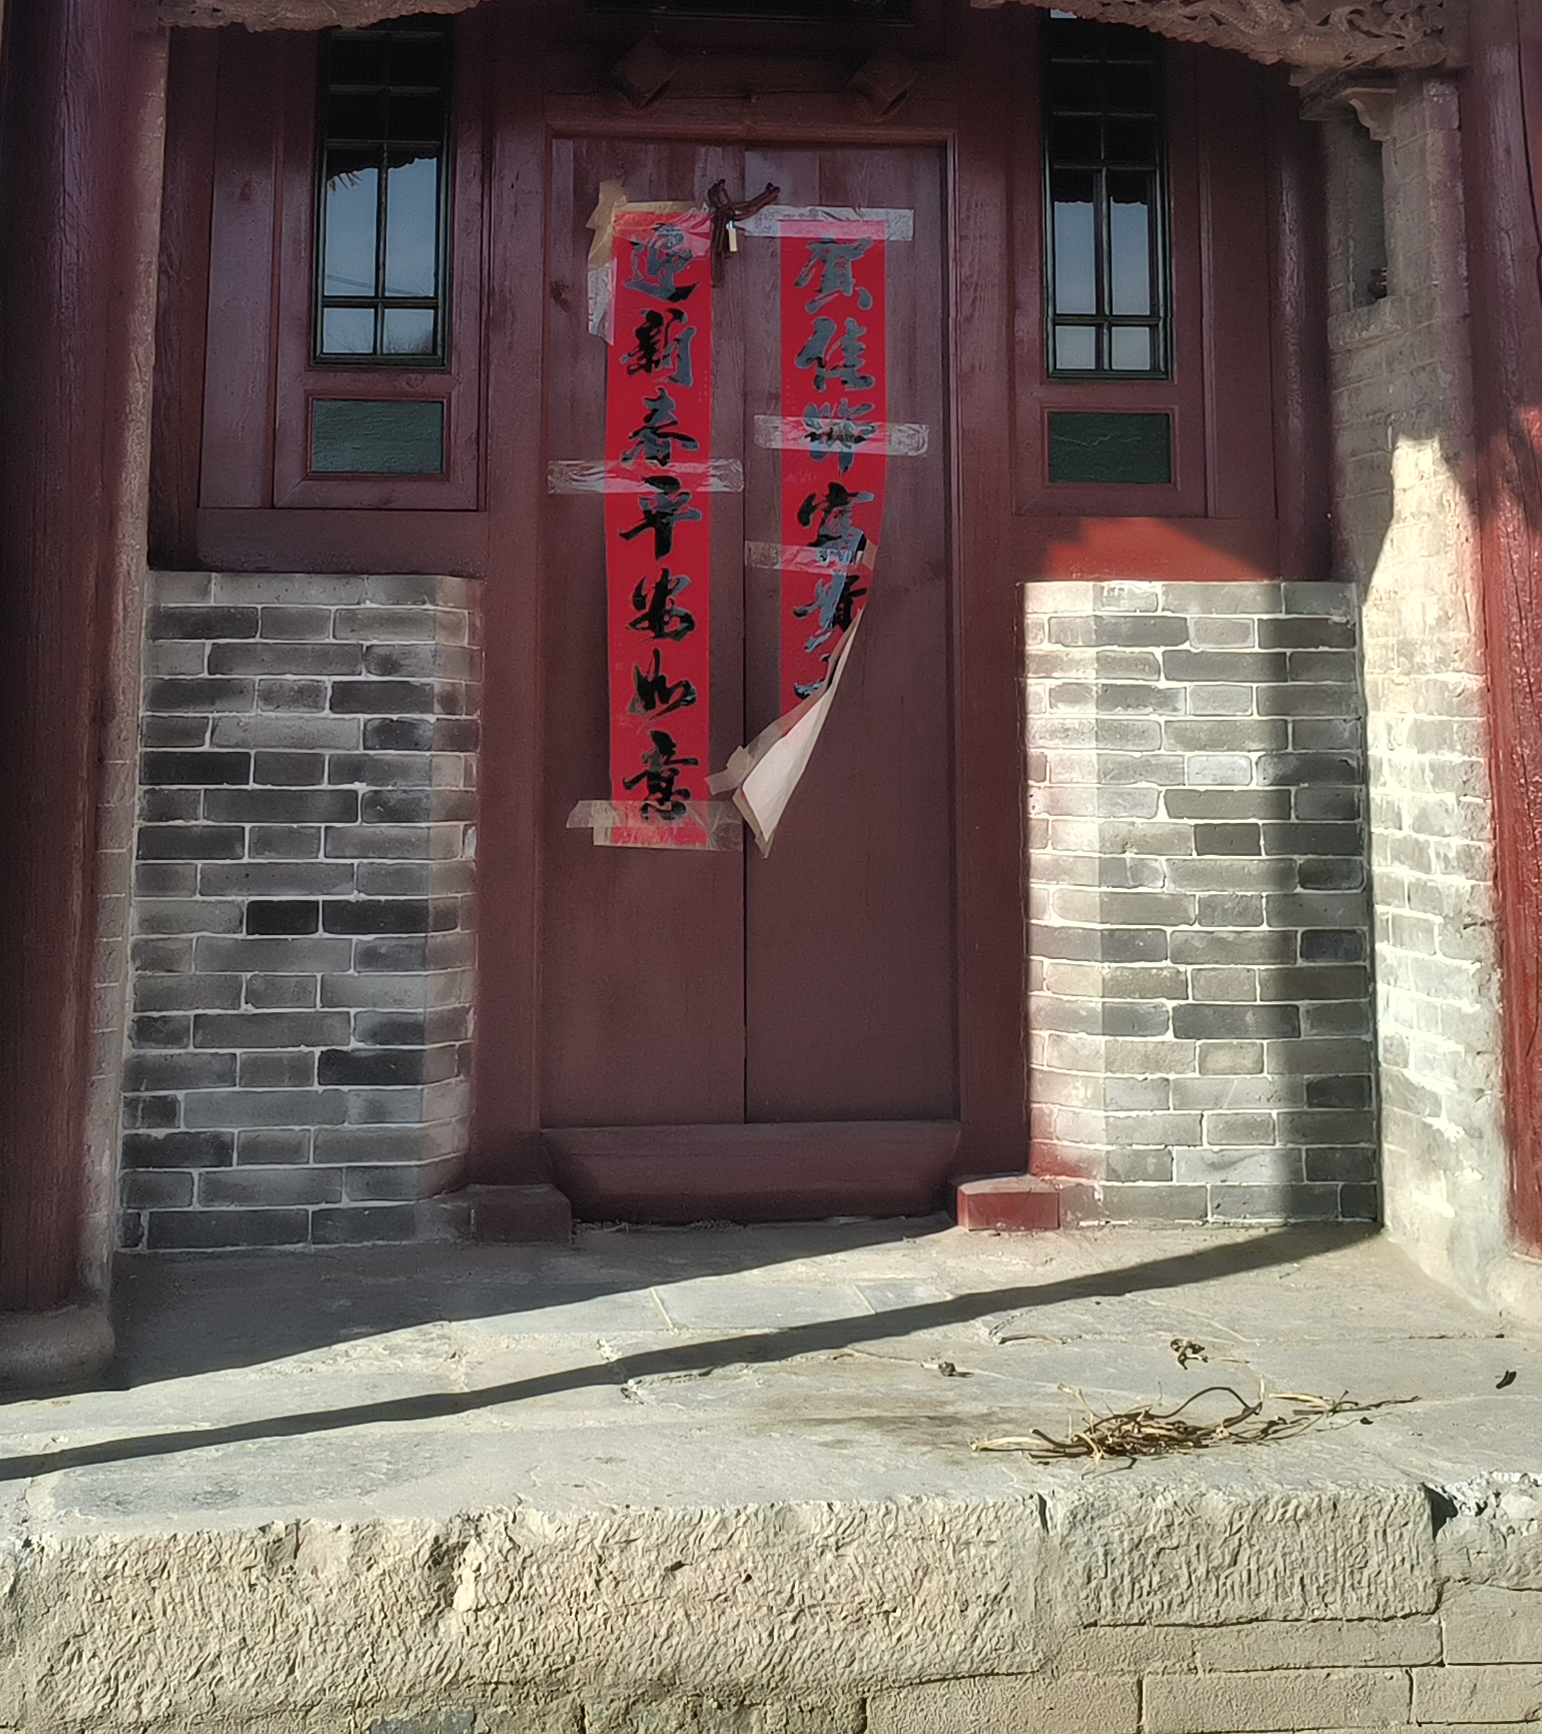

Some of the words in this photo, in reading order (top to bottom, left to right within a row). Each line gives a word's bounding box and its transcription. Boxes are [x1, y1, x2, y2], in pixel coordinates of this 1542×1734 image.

[619, 223, 702, 821] 迎新春平安如意
